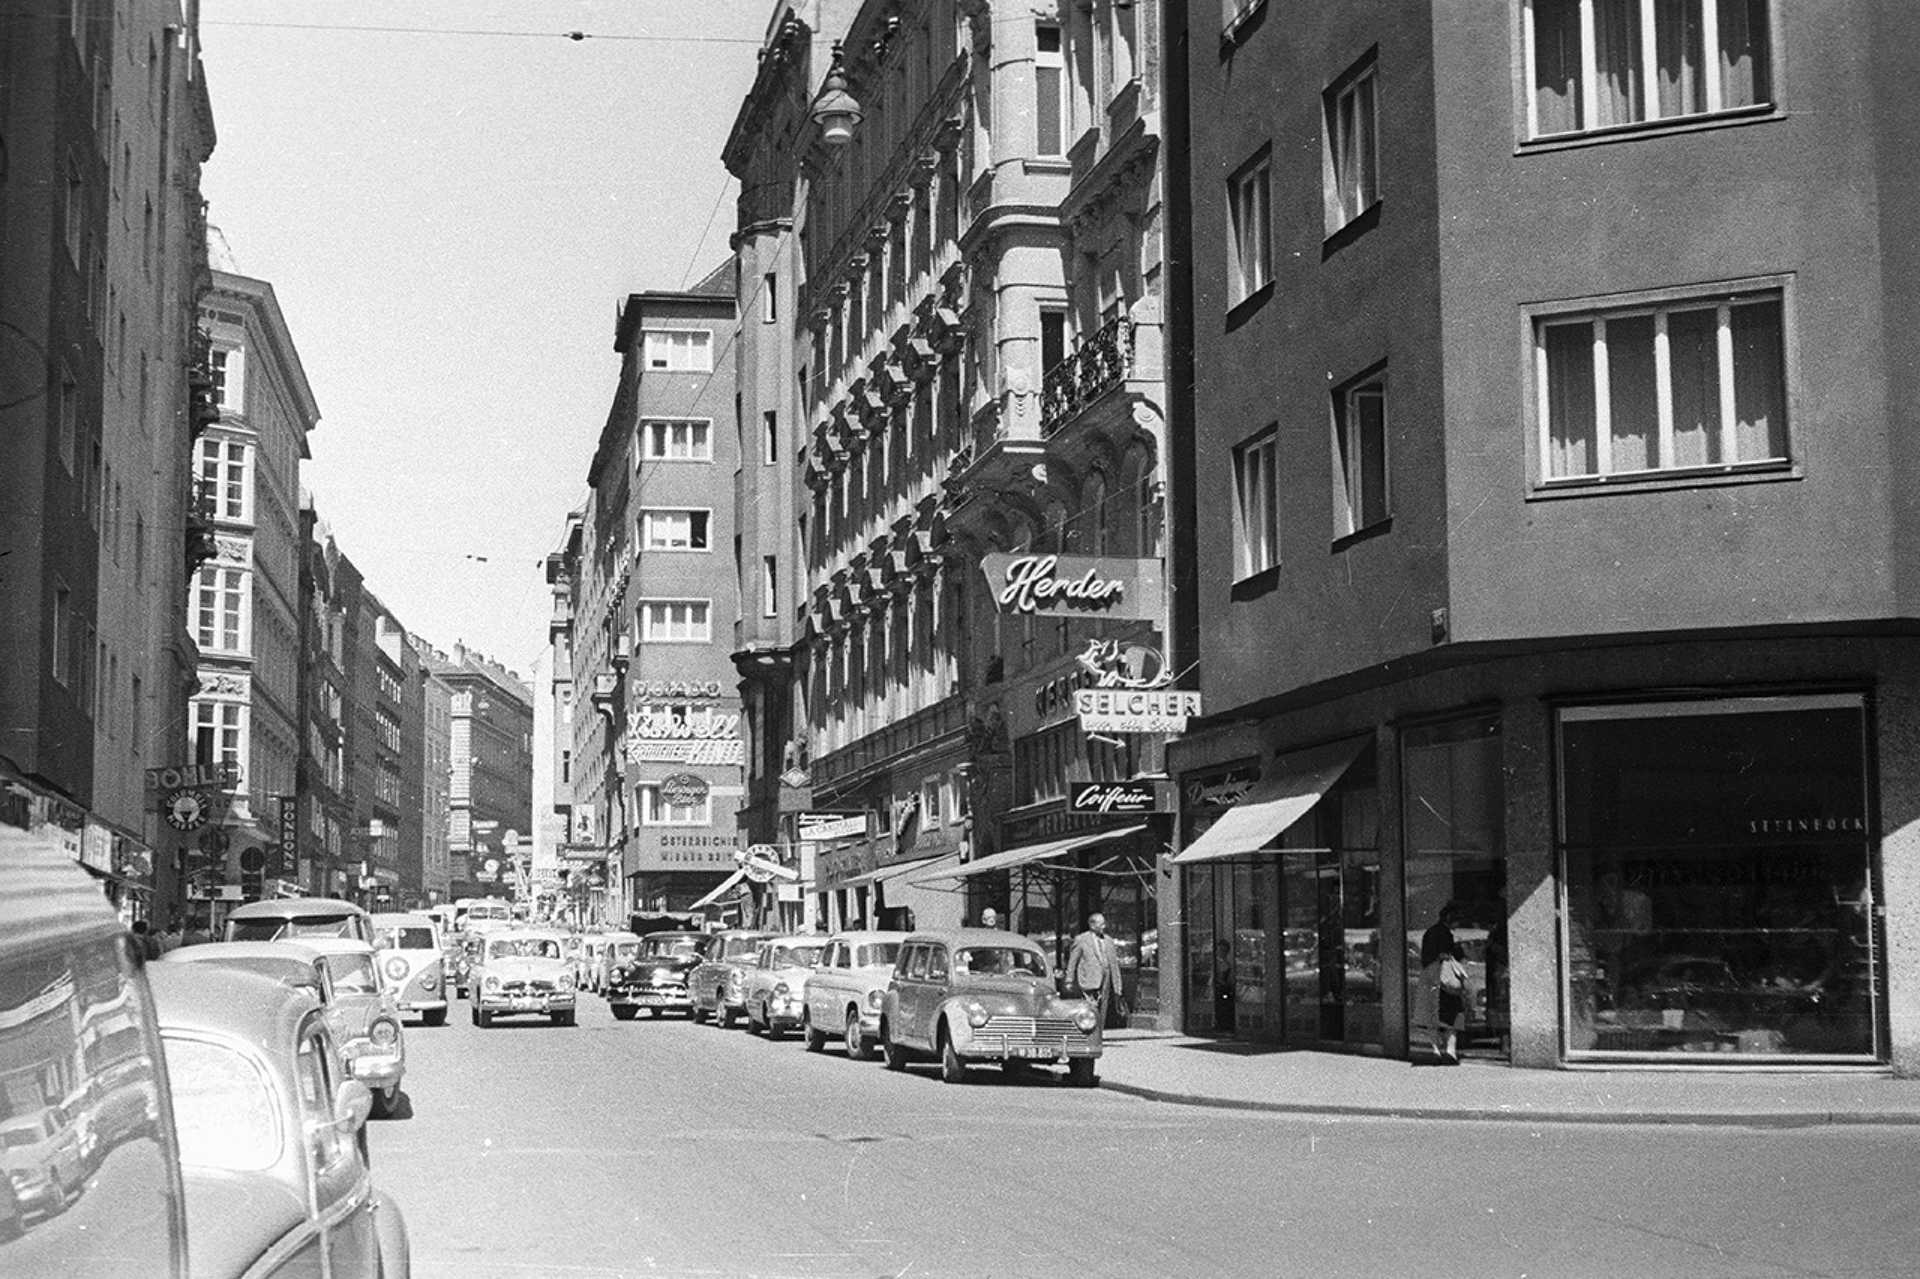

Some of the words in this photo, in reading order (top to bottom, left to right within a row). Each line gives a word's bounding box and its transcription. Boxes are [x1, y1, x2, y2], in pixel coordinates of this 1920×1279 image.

[1000, 554, 1125, 611] Herder
[1078, 693, 1197, 717] SELCHER
[1075, 784, 1154, 813] Coiffeur
[283, 801, 296, 871] BONBONS
